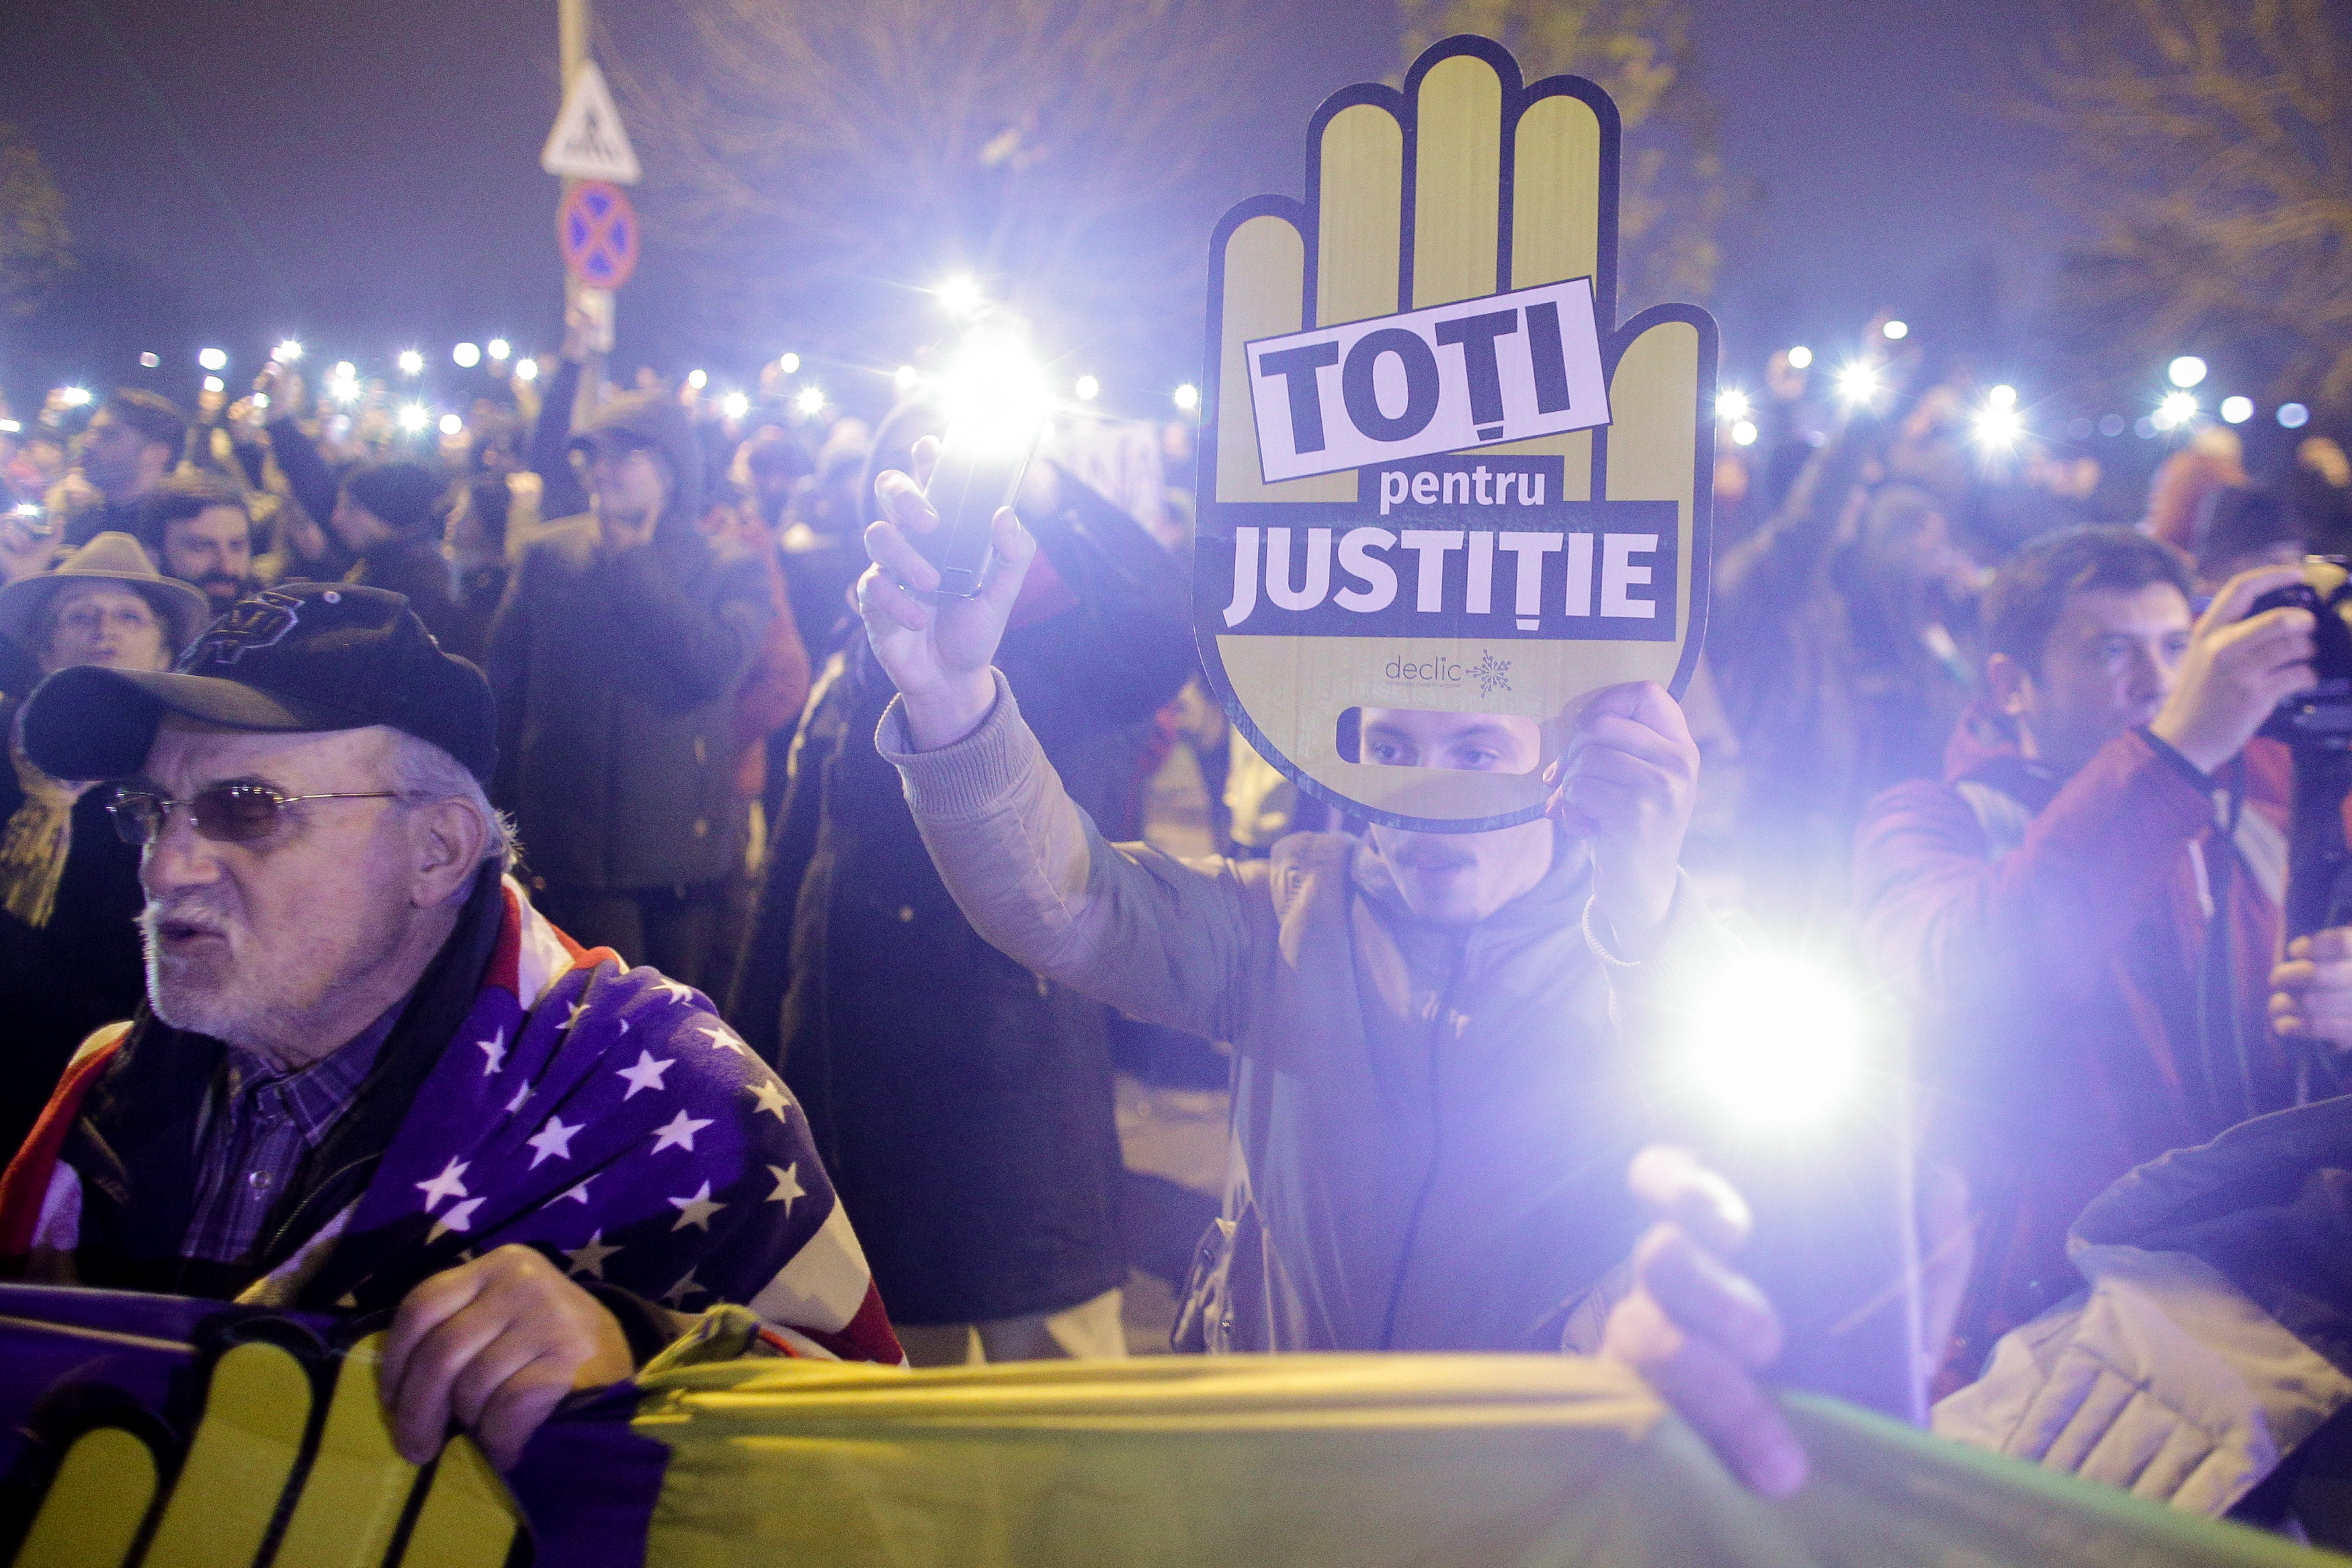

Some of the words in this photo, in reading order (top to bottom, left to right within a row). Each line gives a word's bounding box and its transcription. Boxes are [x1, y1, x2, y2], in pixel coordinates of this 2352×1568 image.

[1259, 301, 1570, 455] TOȚI
[1380, 466, 1546, 515] pentru
[1222, 527, 1659, 631] JUSTIȚIE
[1386, 655, 1461, 681] declic
